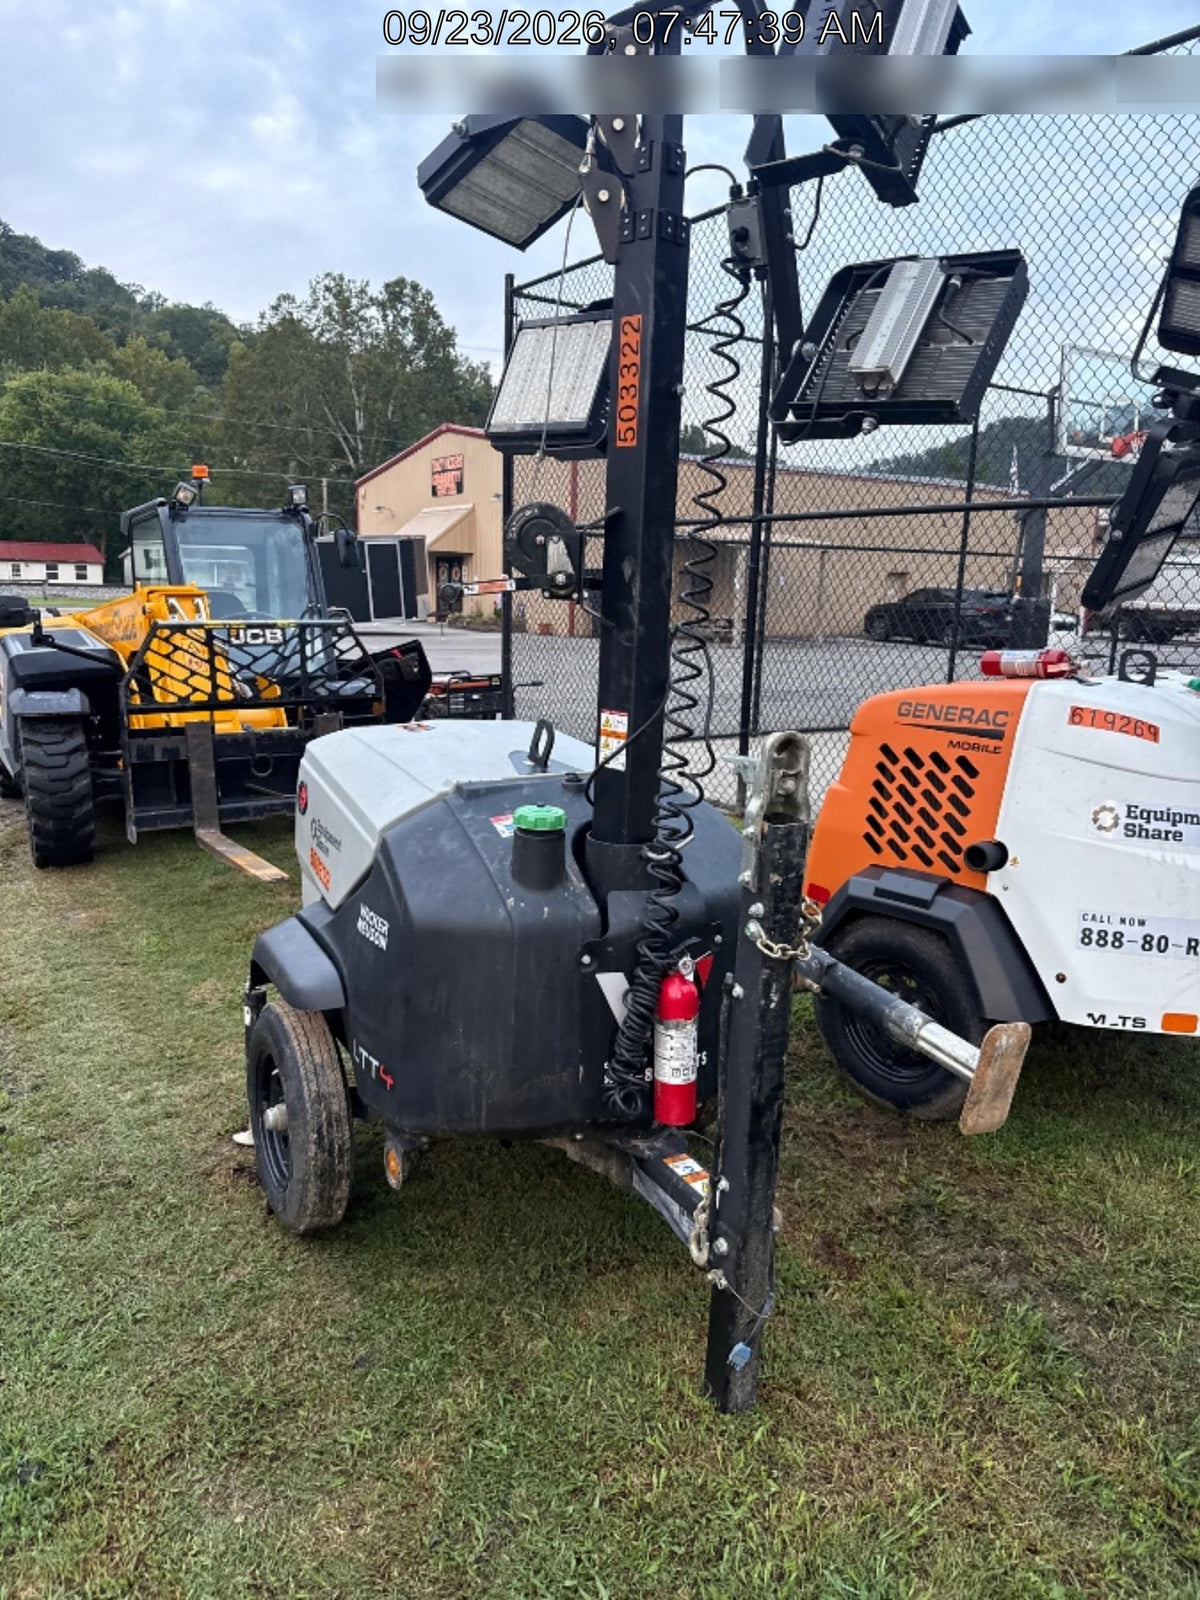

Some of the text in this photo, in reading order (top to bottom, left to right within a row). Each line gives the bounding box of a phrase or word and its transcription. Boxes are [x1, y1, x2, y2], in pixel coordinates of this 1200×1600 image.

[618, 318, 641, 443] 503322
[229, 628, 284, 645] JCB
[897, 701, 1009, 728] GENERAC
[1070, 707, 1158, 743] 619269
[947, 740, 1002, 755] MOBILE
[1125, 804, 1200, 827] Equipm
[1123, 822, 1184, 842] Share
[1082, 912, 1147, 927] CALL NOW
[1080, 927, 1200, 957] 888-80-R
[353, 1037, 394, 1091] LTT4
